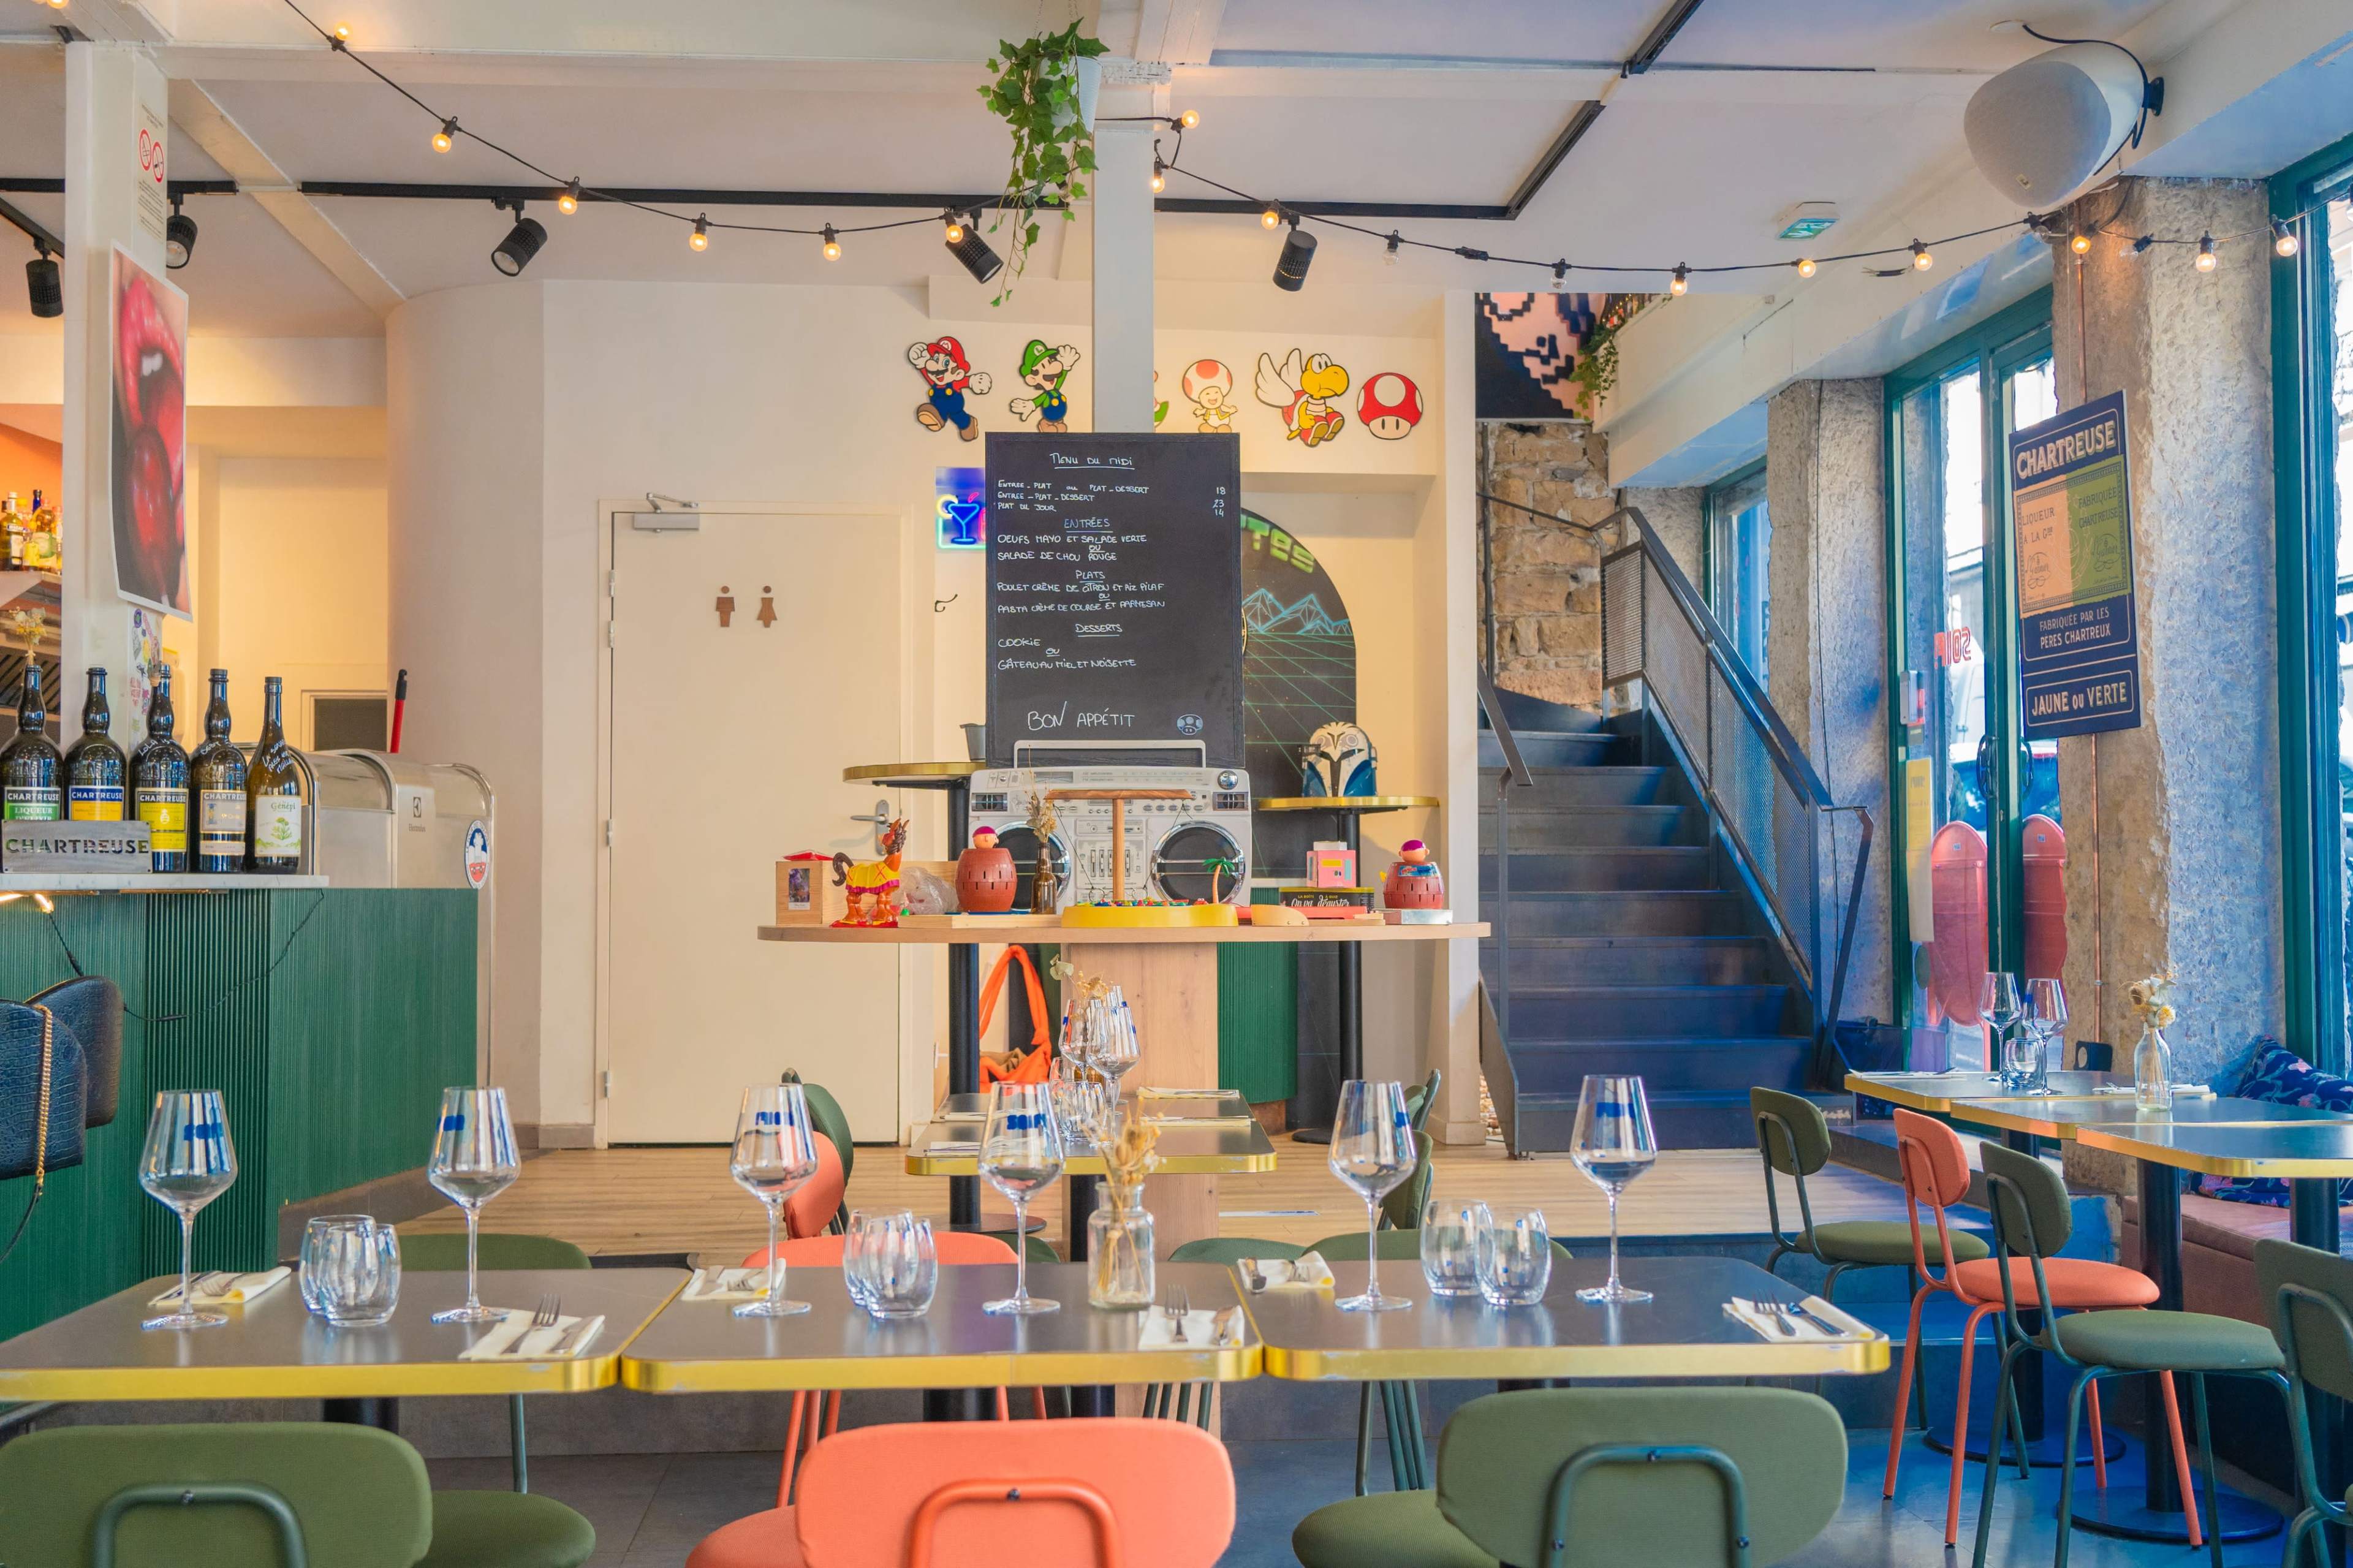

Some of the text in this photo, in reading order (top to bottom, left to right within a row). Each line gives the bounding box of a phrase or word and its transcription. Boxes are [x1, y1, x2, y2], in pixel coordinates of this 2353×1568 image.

[2017, 420, 2116, 479] CHARTREUSE
[1216, 487, 1226, 495] 18
[1213, 499, 1225, 509] 23
[2021, 507, 2055, 526] LIQUEUR
[2079, 507, 2119, 529] CHARTREUSE
[1064, 517, 1110, 529] ENTRÉES
[998, 535, 1030, 545] OEUFS
[1036, 535, 1061, 544] MAYO
[1081, 536, 1117, 544] SALADE
[2031, 531, 2042, 543] LA
[998, 551, 1035, 561] SALADE
[1056, 553, 1080, 561] CHOU
[1088, 553, 1117, 561] ROUGE
[1075, 570, 1105, 580] PLATS
[997, 582, 1029, 592] POULET
[2039, 607, 2109, 631] FABRIQUÉE PAR LES
[1075, 624, 1123, 633] DESSERTS
[2040, 623, 2111, 650] PÈRES CHARTREUX
[998, 658, 1039, 670] GÂTEAU
[1039, 661, 1053, 669] AU
[1077, 660, 1089, 668] ET
[2032, 691, 2069, 716] JAUNE
[2086, 681, 2128, 708] VERTE
[1027, 701, 1135, 731] BON APPÉTIT
[7, 793, 59, 801] CHARTREUSE
[271, 802, 296, 813] Génépi
[6, 838, 150, 854] CHARTREUSE
